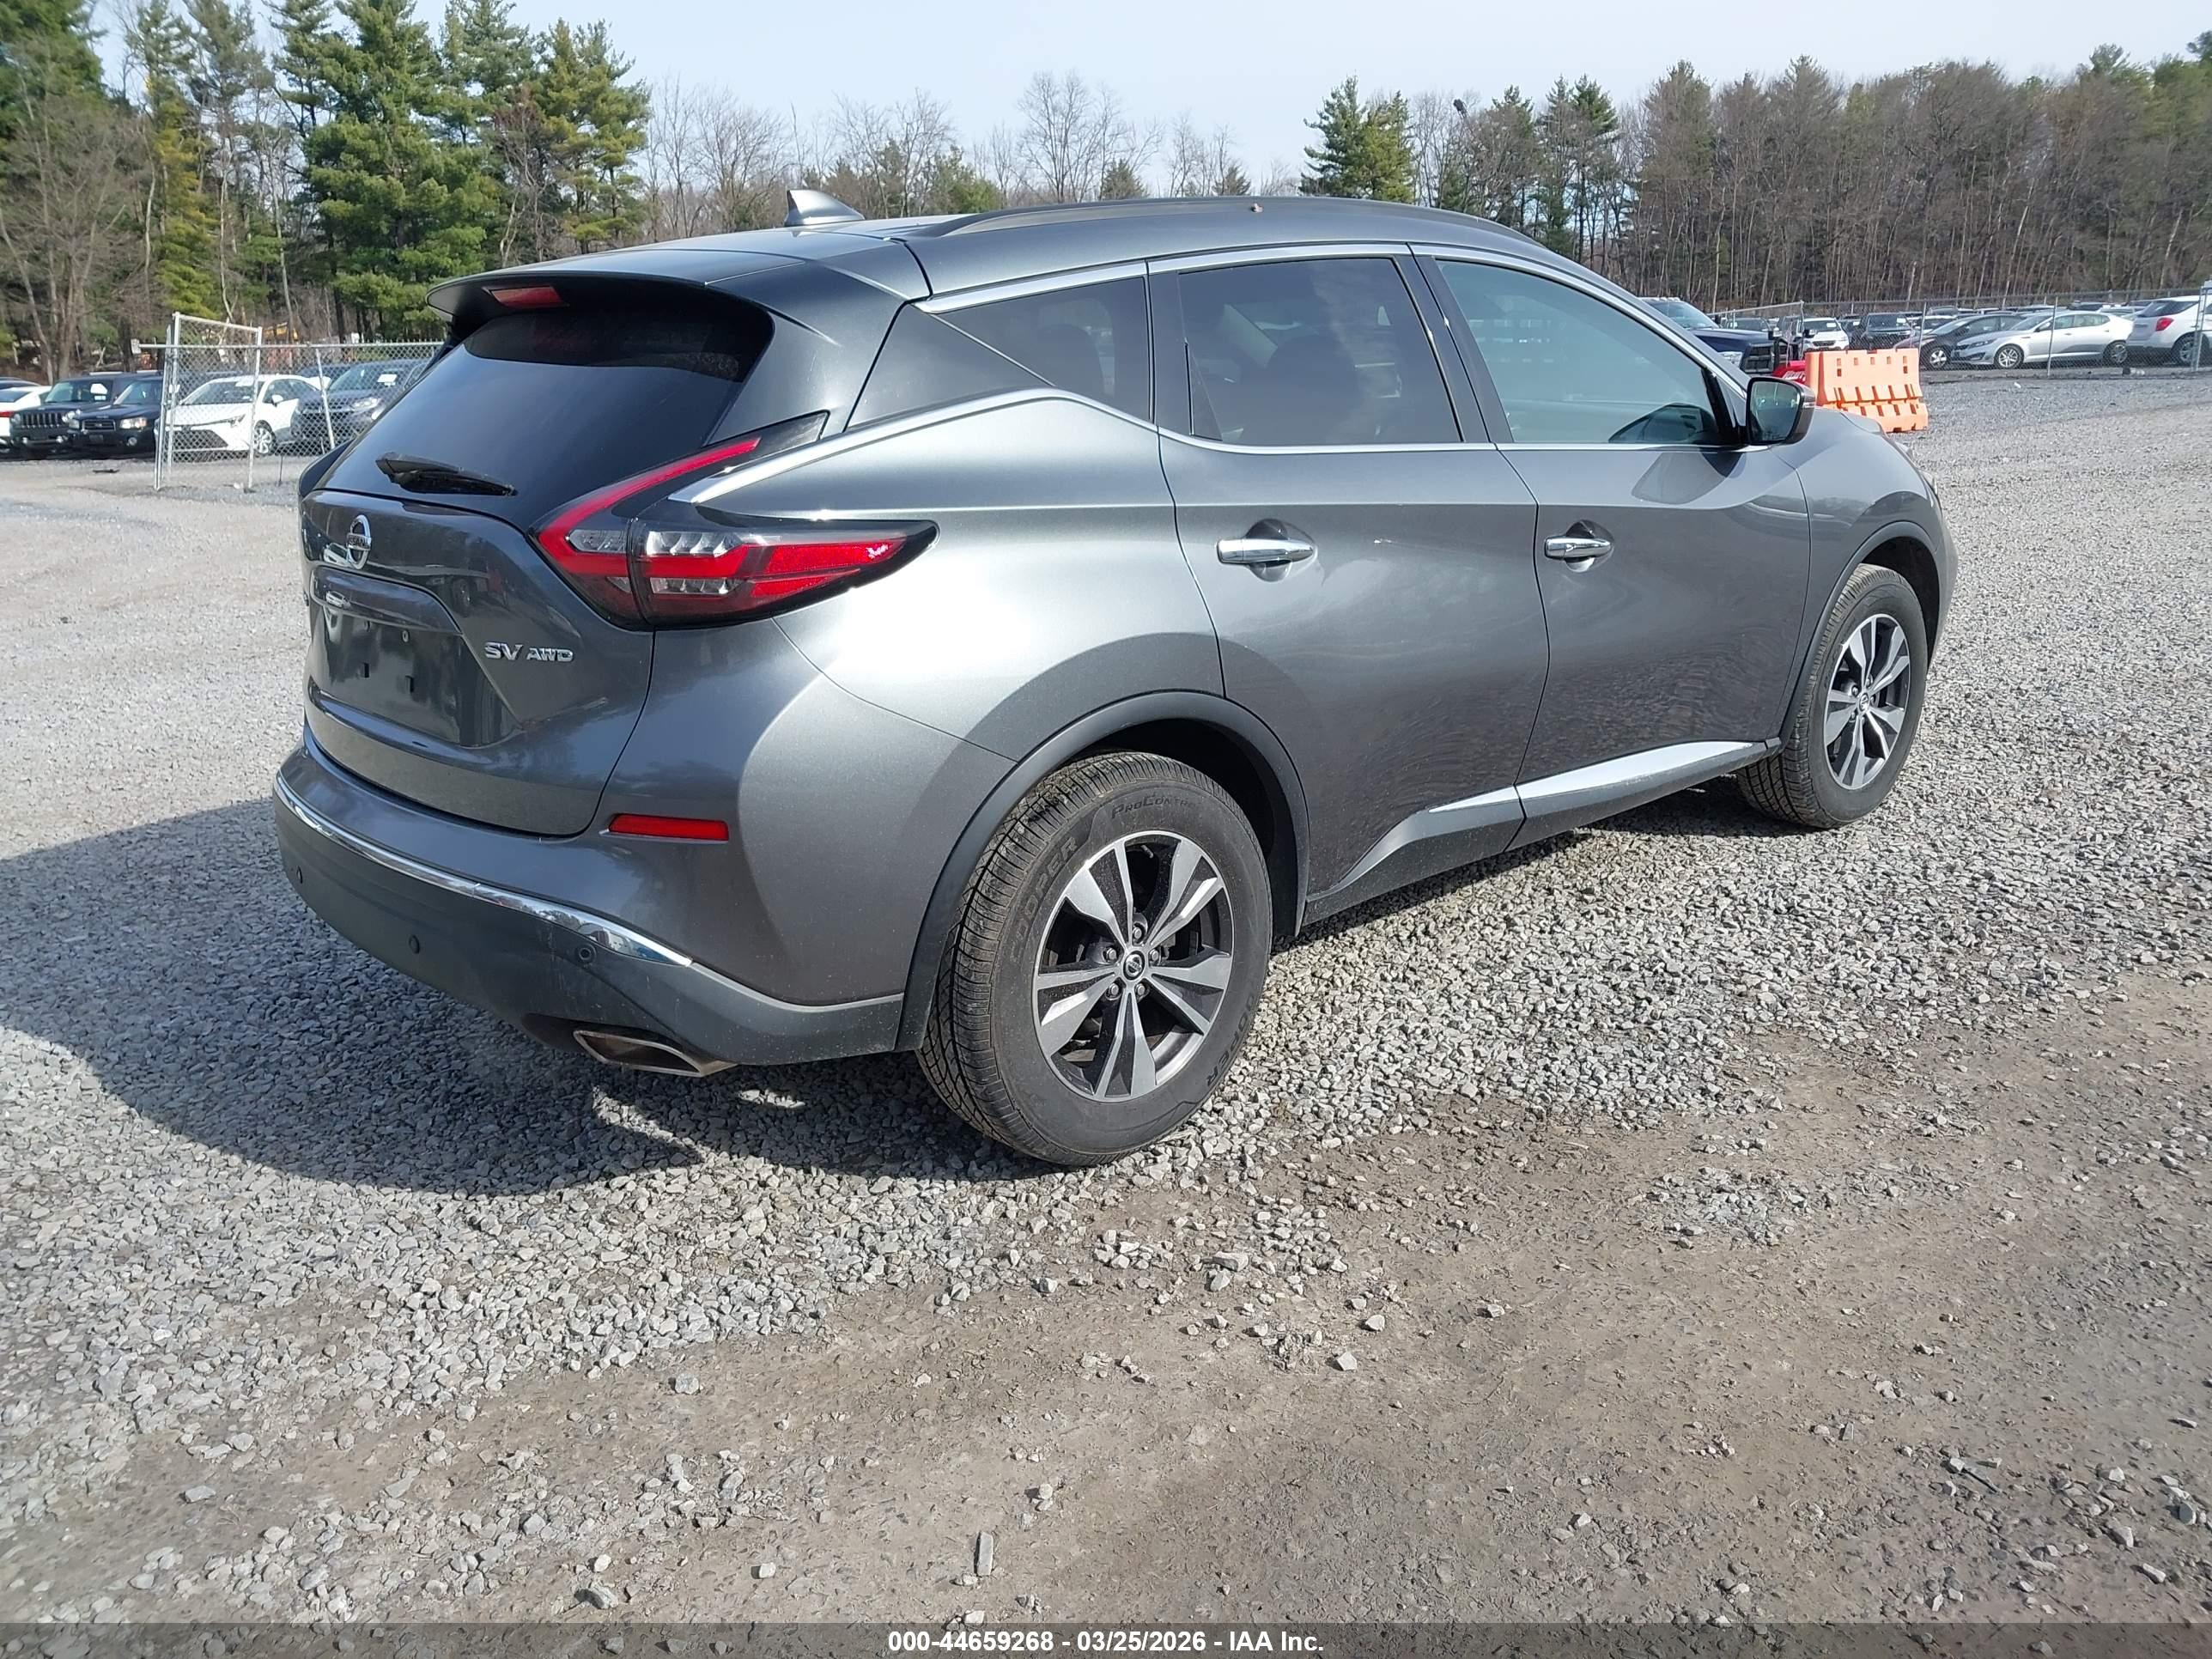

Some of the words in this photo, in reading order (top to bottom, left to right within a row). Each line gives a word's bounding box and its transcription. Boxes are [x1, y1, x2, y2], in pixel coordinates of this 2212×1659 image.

[483, 641, 524, 661] SV
[526, 647, 574, 663] AWD
[1206, 981, 1256, 1086] OOPER
